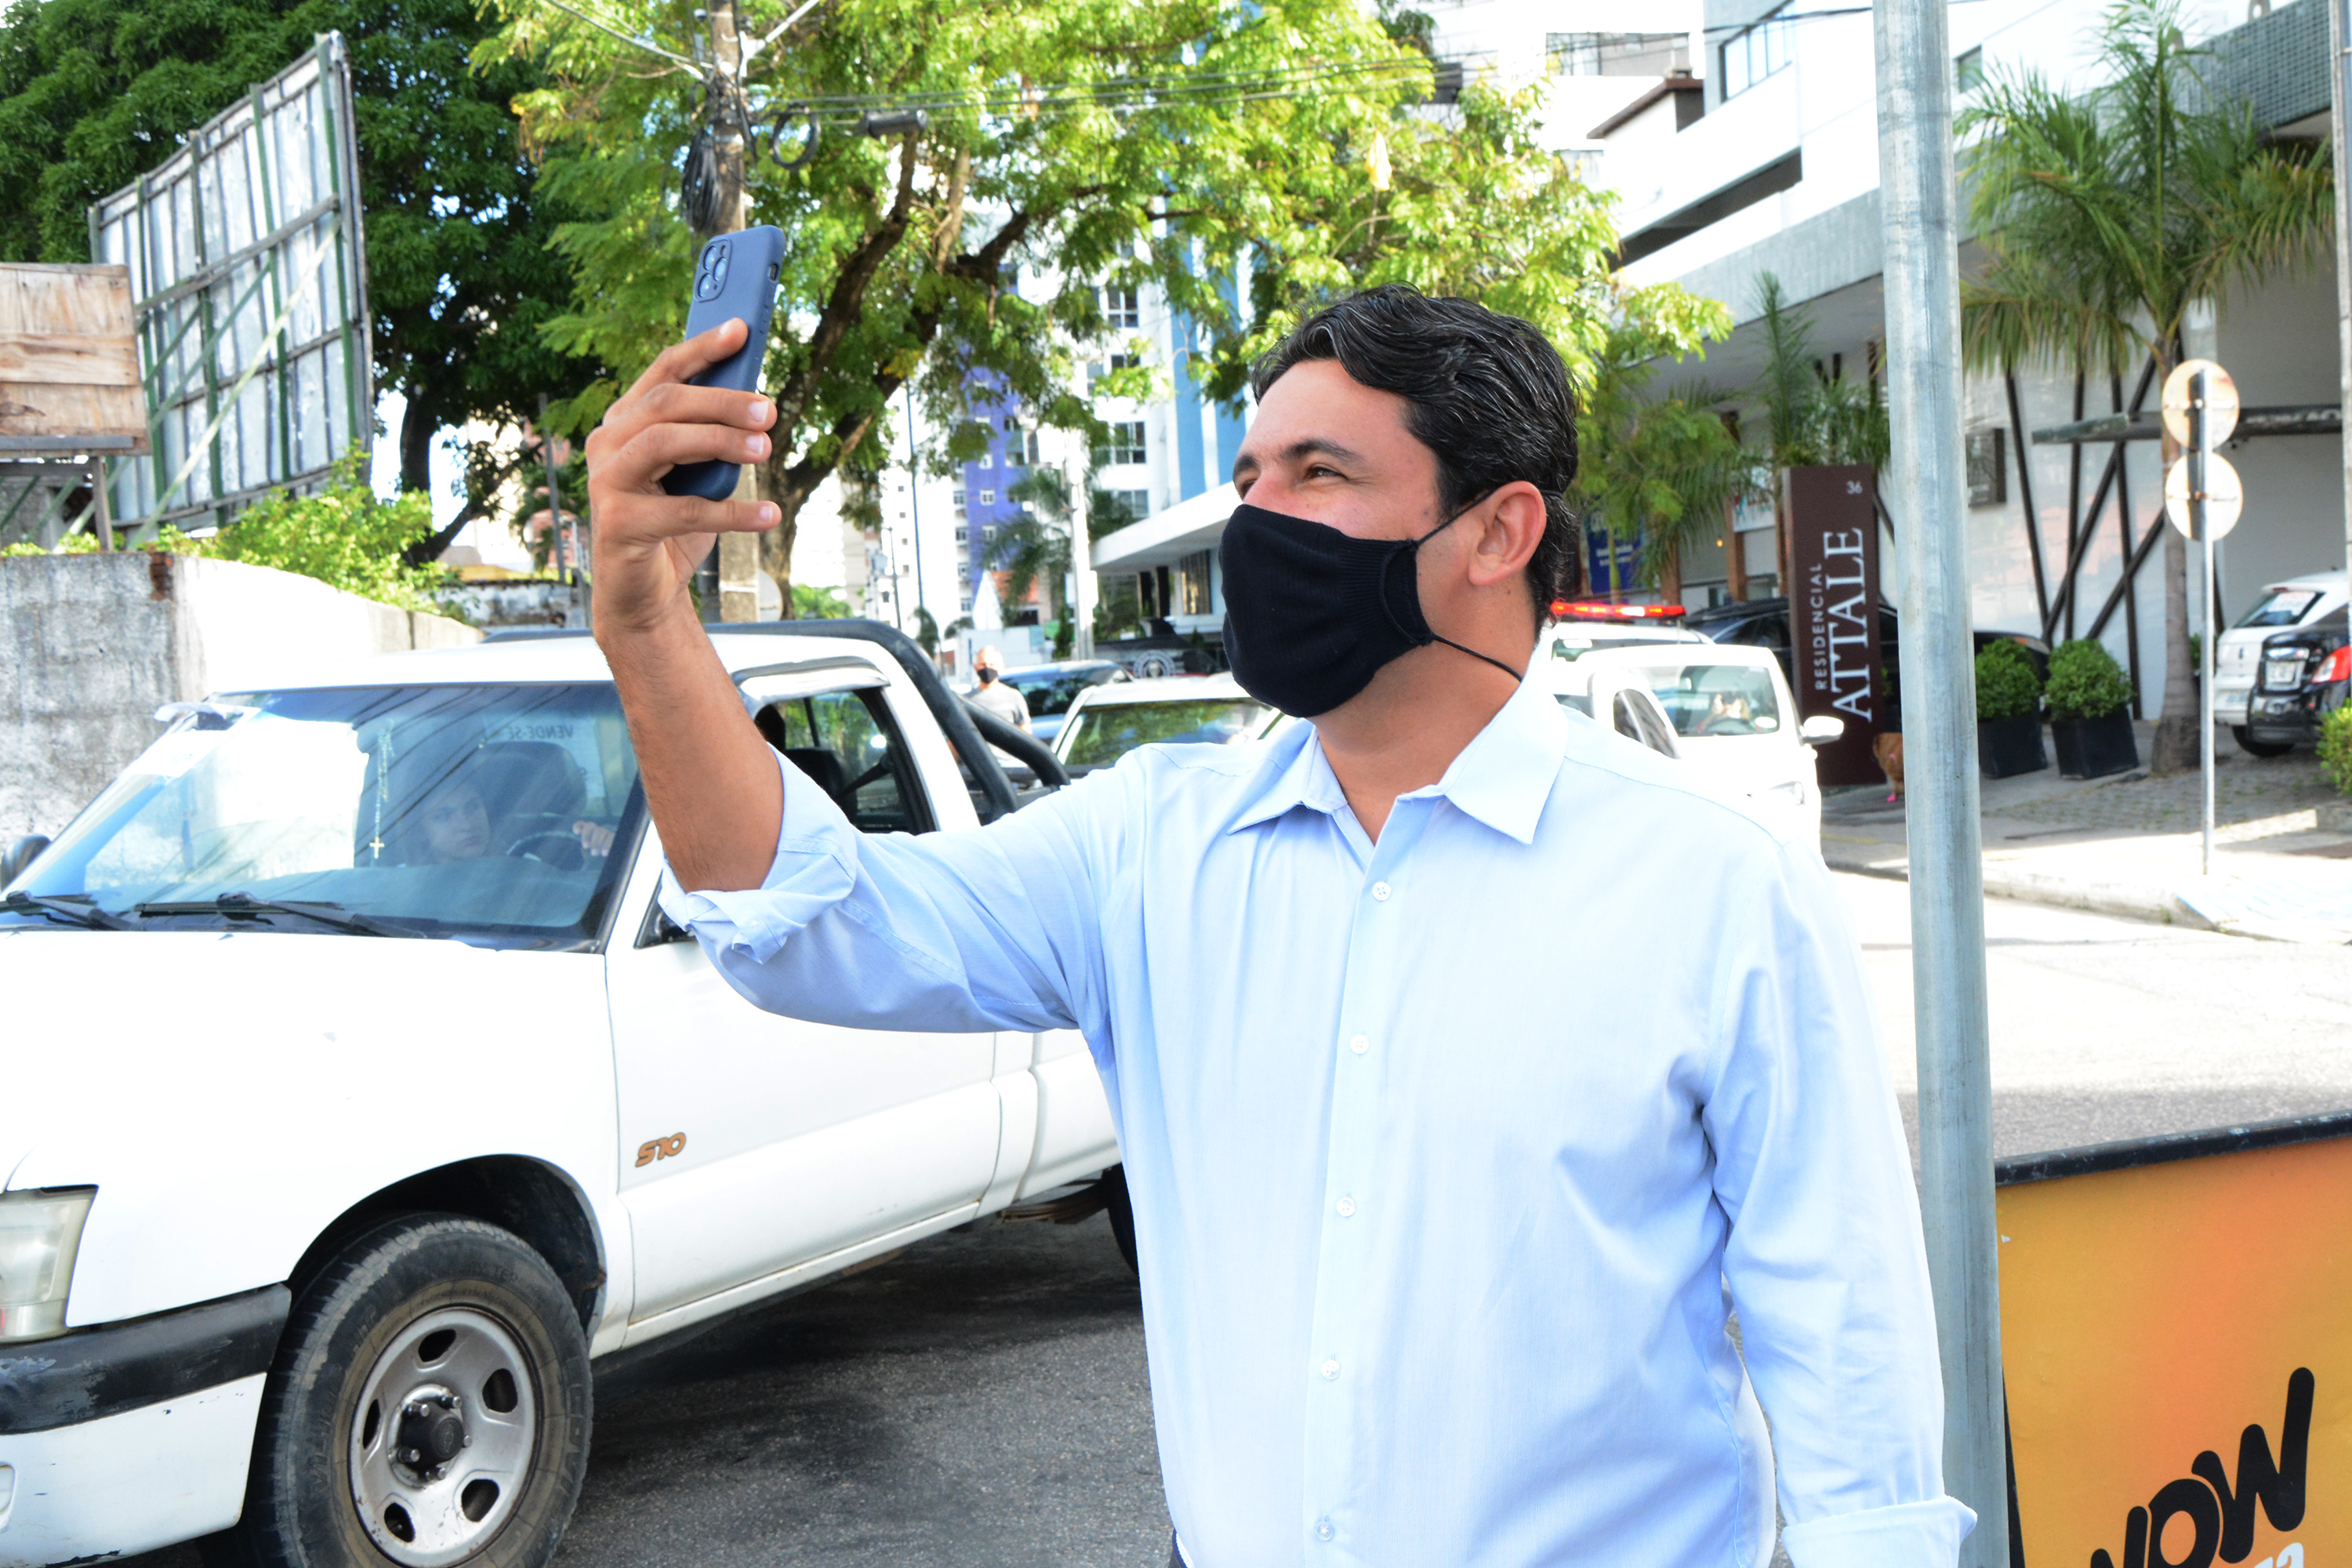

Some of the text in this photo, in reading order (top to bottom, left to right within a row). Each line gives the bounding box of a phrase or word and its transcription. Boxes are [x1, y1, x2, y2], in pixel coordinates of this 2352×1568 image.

[1846, 480, 1863, 495] 36
[1809, 562, 1828, 691] RESIDENCIAL
[1823, 527, 1872, 723] ATTALE
[635, 1131, 686, 1168] S10
